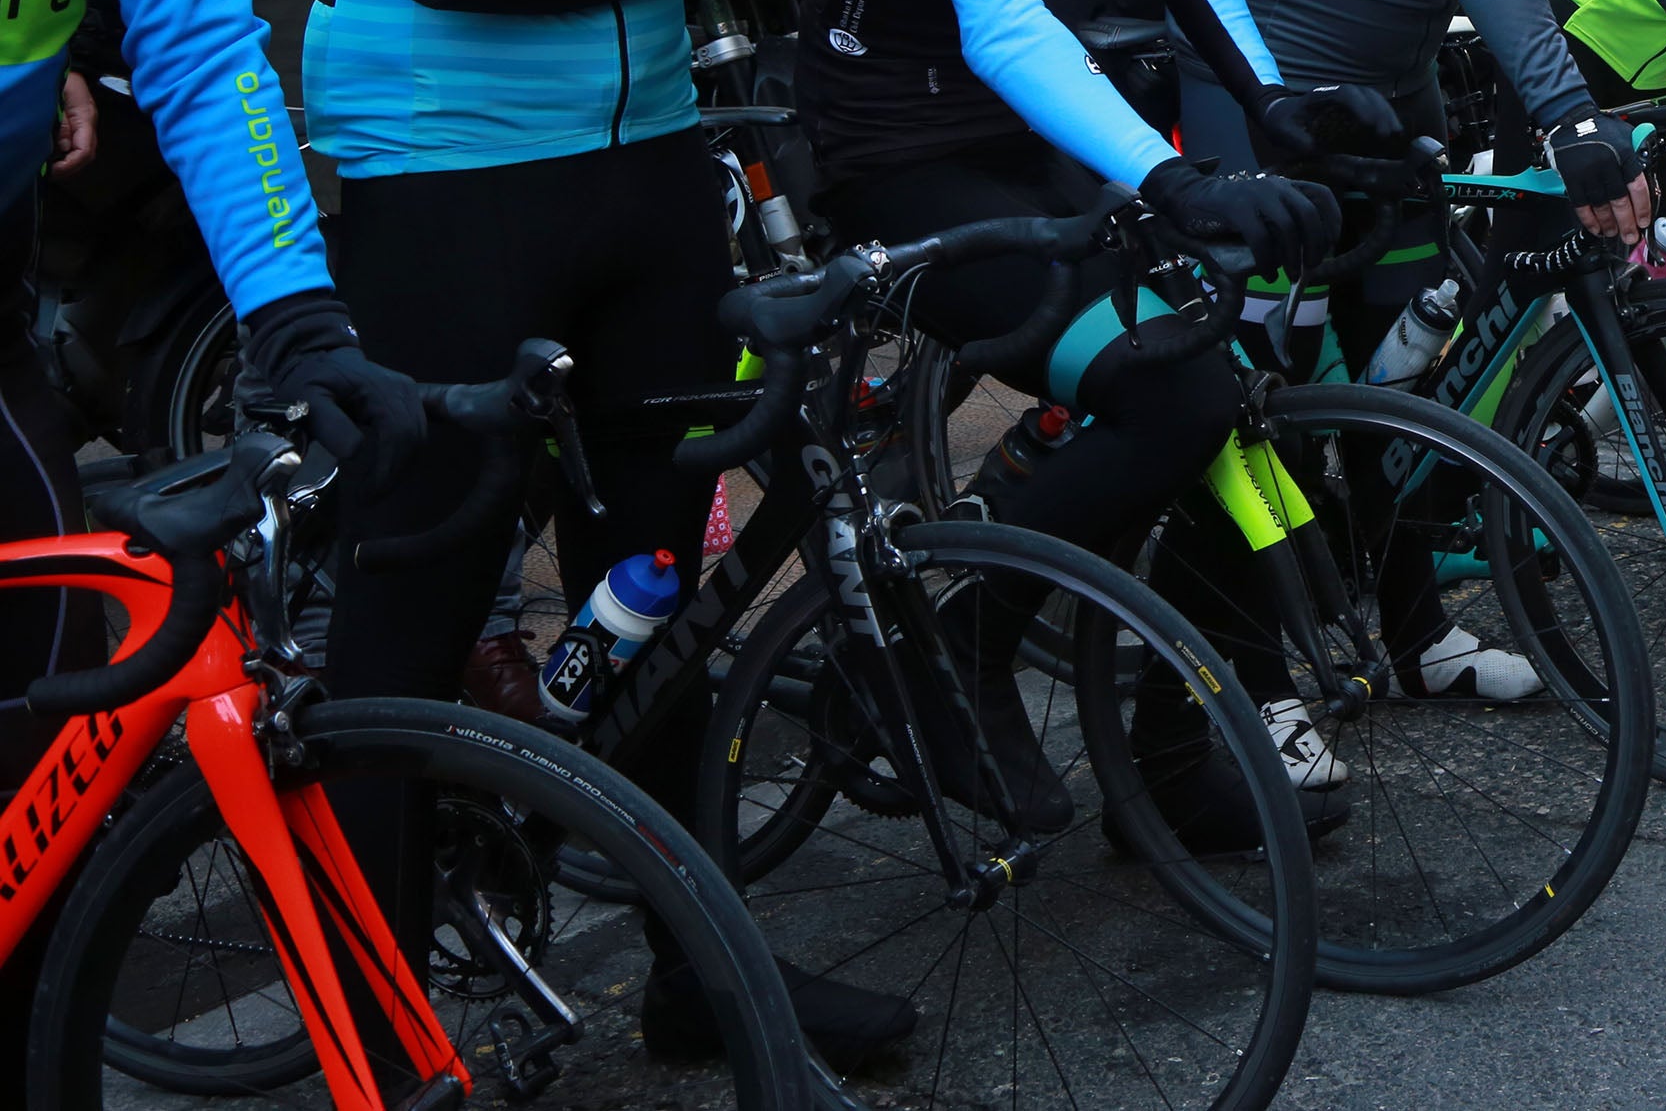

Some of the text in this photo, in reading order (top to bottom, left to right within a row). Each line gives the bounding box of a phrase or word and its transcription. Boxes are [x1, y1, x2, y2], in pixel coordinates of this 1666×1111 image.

[674, 389, 754, 402] ADVANCED
[801, 444, 887, 649] GIANT
[455, 726, 637, 826] vittoria RUBINO PRO CONTROL
